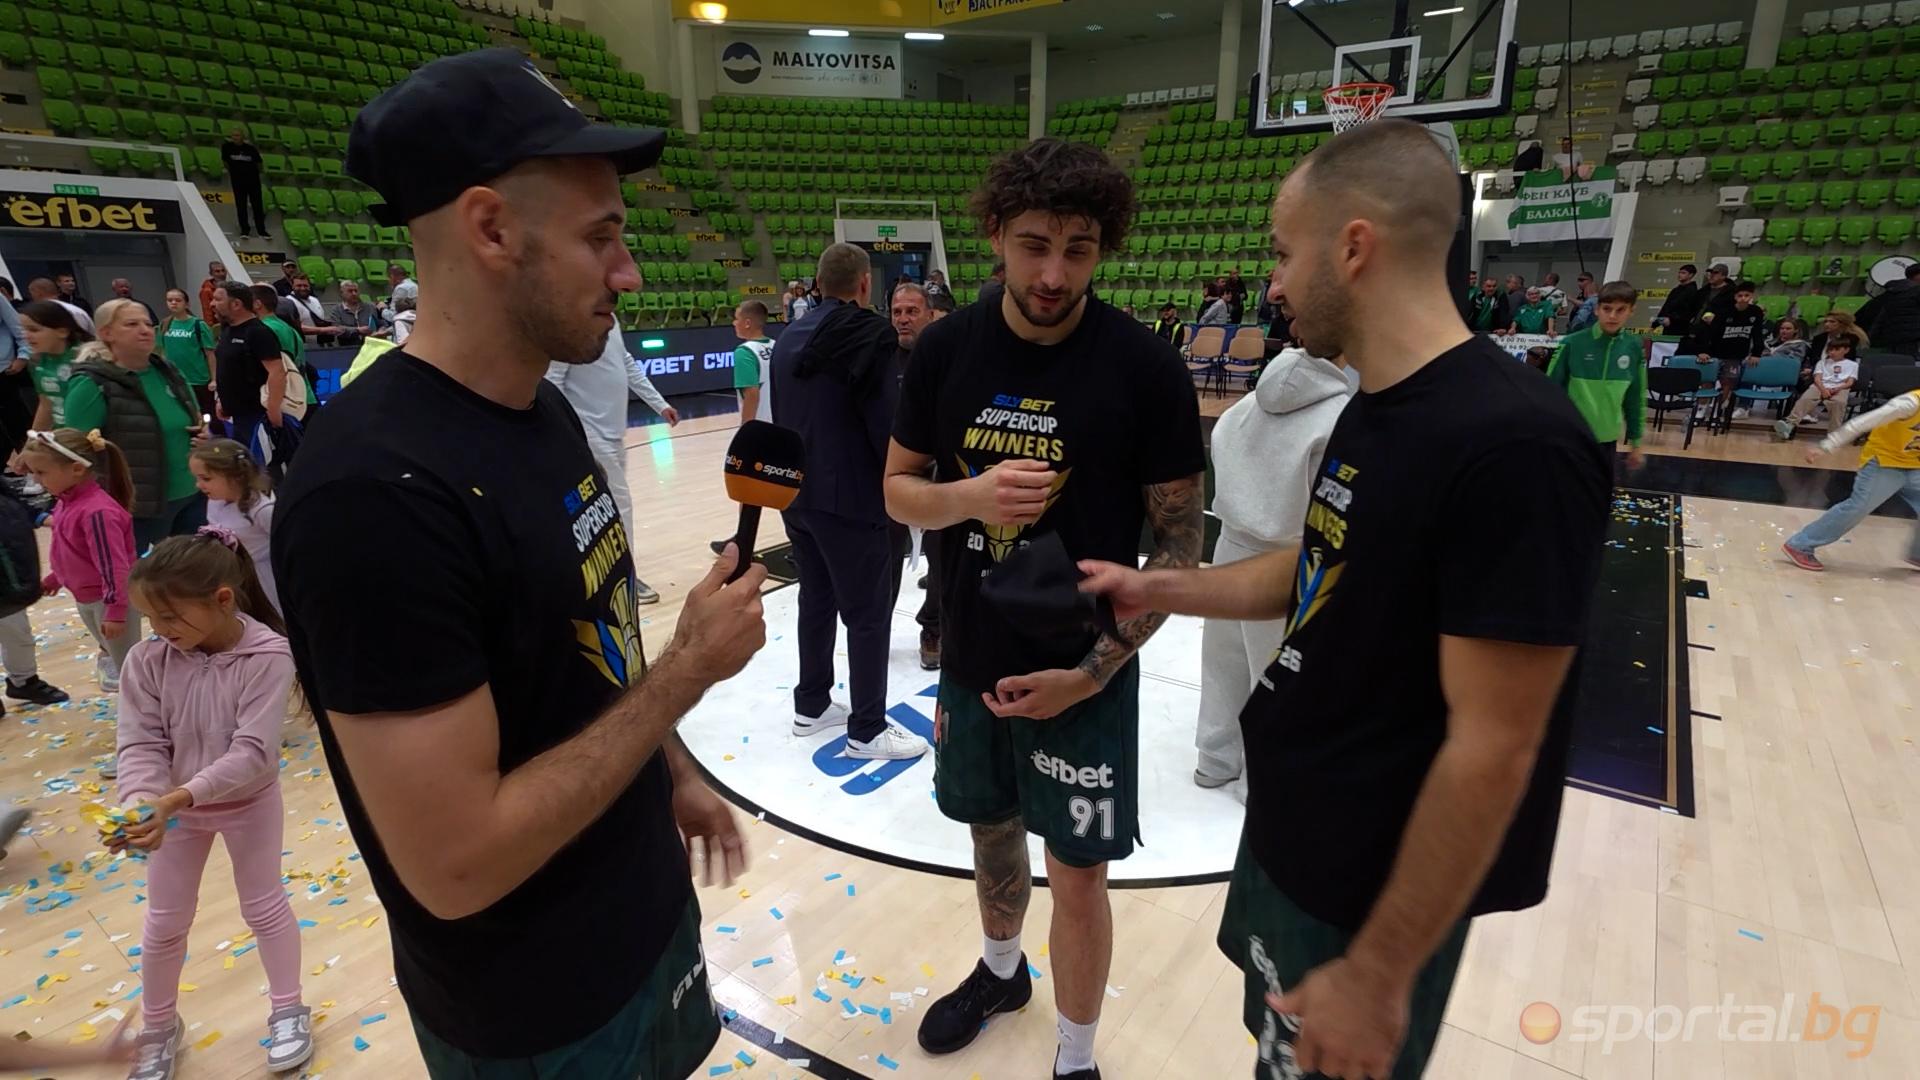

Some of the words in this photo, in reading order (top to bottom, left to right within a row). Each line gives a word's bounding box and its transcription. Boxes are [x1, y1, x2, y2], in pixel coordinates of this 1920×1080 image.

[773, 51, 896, 71] MALYOVITSA
[1526, 206, 1581, 220] БАЛКАН
[873, 242, 905, 252] efbet
[748, 284, 769, 294] efbet
[992, 393, 1055, 412] SLYBET
[975, 407, 1058, 433] SUPERCUP
[963, 427, 1064, 462] WINNERS
[572, 492, 616, 552] SUPERCUP
[967, 531, 984, 551] 20
[581, 520, 629, 600] WINNER
[1068, 796, 1115, 840] 91
